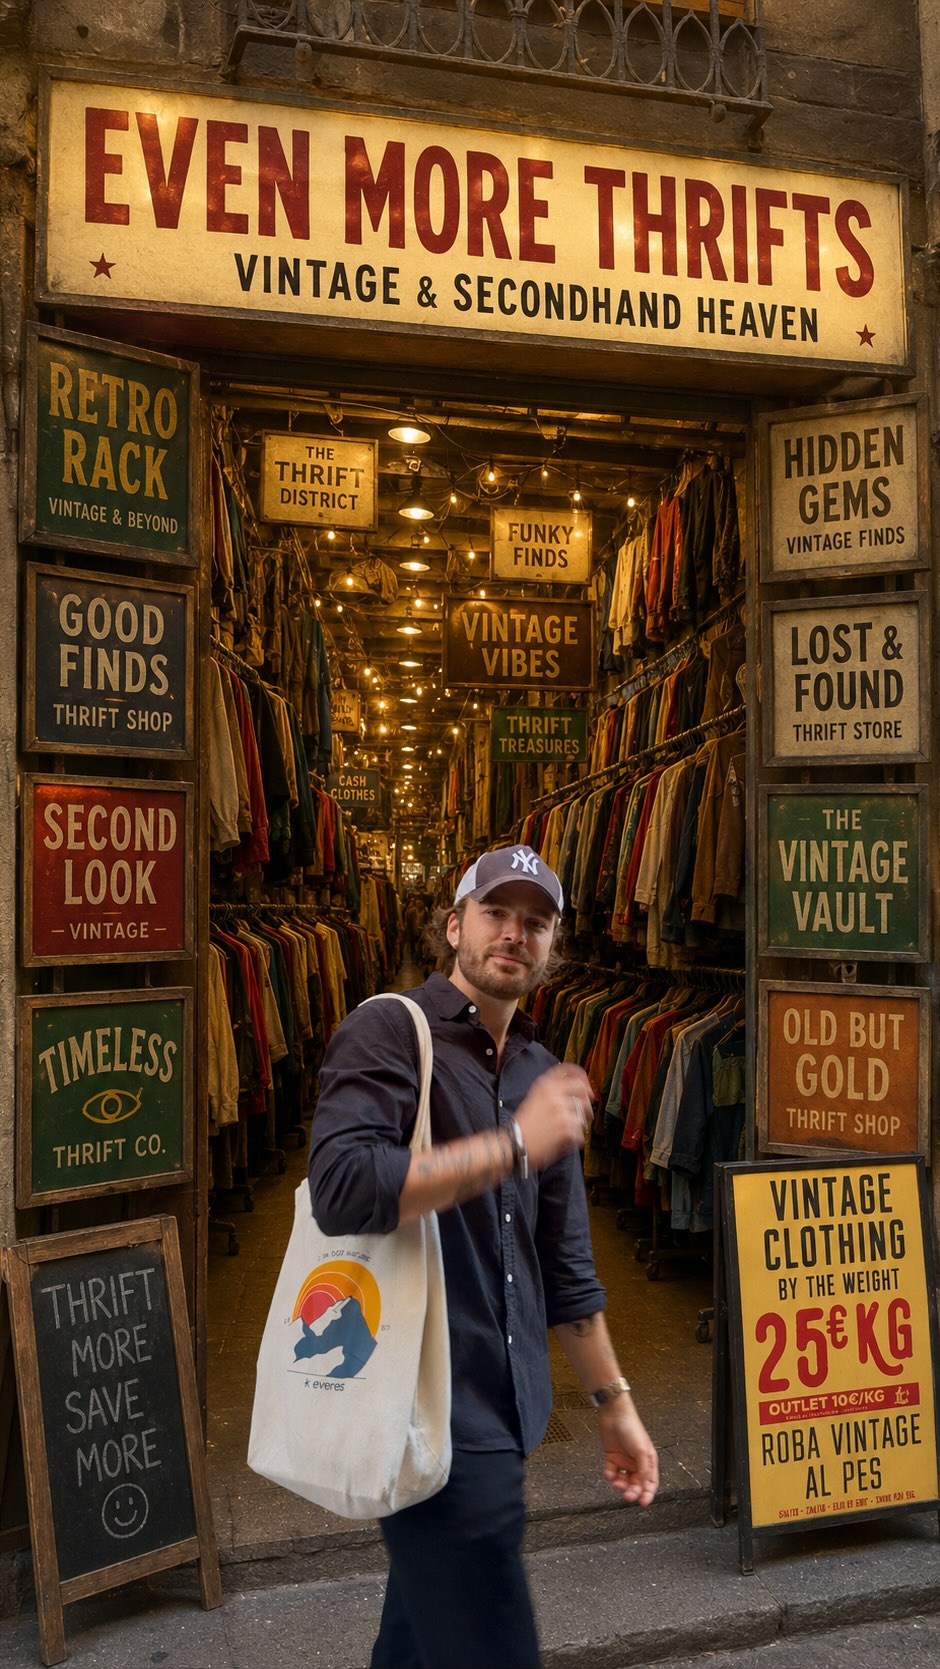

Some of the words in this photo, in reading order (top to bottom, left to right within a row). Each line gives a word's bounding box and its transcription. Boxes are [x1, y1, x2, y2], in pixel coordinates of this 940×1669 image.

[84, 107, 311, 241] EVEN
[344, 134, 556, 265] MORE
[583, 165, 875, 299] THRIFTS
[232, 253, 401, 306] VINTAGE
[417, 274, 438, 308] &
[453, 274, 681, 331] SECONDHAND
[696, 296, 819, 343] HEAVEN
[49, 361, 178, 440] RETRO
[62, 428, 168, 501] RACK
[305, 445, 334, 461] THE
[784, 424, 905, 480] HIDDEN
[274, 460, 365, 489] THRIFT
[48, 496, 107, 524] VINTAGE
[112, 508, 122, 526] &
[127, 510, 178, 536] BEYOND
[280, 488, 358, 511] DISTRICT
[798, 476, 891, 526] GEMS
[508, 522, 575, 545] FUNKY
[786, 530, 853, 555] VINTAGE
[859, 525, 905, 549] FINDS
[513, 547, 569, 569] FINDS
[59, 593, 165, 646] GOOD
[461, 611, 578, 645] VINTAGE
[481, 647, 561, 679] VIBES
[790, 622, 873, 666] LOST
[881, 625, 904, 661] &
[59, 643, 170, 697] FINDS
[794, 668, 904, 712] FOUND
[53, 703, 120, 730] THRIFT
[126, 709, 173, 733] SHOP
[507, 716, 572, 735] THRIFT
[793, 721, 847, 743] THRIFT
[853, 720, 903, 741] STORE
[499, 737, 580, 755] TREASURES
[331, 788, 375, 801] CLOTHES
[339, 775, 366, 787] CASH
[43, 802, 177, 852] SECOND
[822, 808, 862, 830] THE
[63, 859, 157, 905] LOOK
[511, 849, 539, 876] NY
[778, 840, 909, 884] VINTAGE
[69, 922, 149, 940] VINTAGE
[791, 891, 894, 934] VAULT
[783, 1007, 838, 1047] OLD
[849, 1011, 905, 1051] BUT
[38, 1026, 177, 1095] TIMELESS
[795, 1052, 890, 1102] GOLD
[785, 1107, 847, 1133] THRIFT
[854, 1112, 901, 1137] SHOP
[52, 1138, 126, 1169] THRIFT
[135, 1133, 166, 1158] CO.
[769, 1173, 893, 1221] VINTAGE
[763, 1218, 906, 1271] CLOTHING
[40, 1267, 155, 1329] THRIFT
[778, 1277, 798, 1301] BY
[808, 1273, 835, 1298] THE
[842, 1268, 900, 1295] WEIGHT
[71, 1323, 152, 1378] MORE
[64, 1378, 144, 1434] SAVE
[768, 1396, 829, 1416] OUTLET
[831, 1389, 885, 1408] 10€/KG
[76, 1427, 162, 1487] MORE
[761, 1426, 821, 1466] ROBA
[830, 1413, 921, 1456] VINTAGE
[805, 1465, 832, 1500] AL
[843, 1457, 882, 1491] PES
